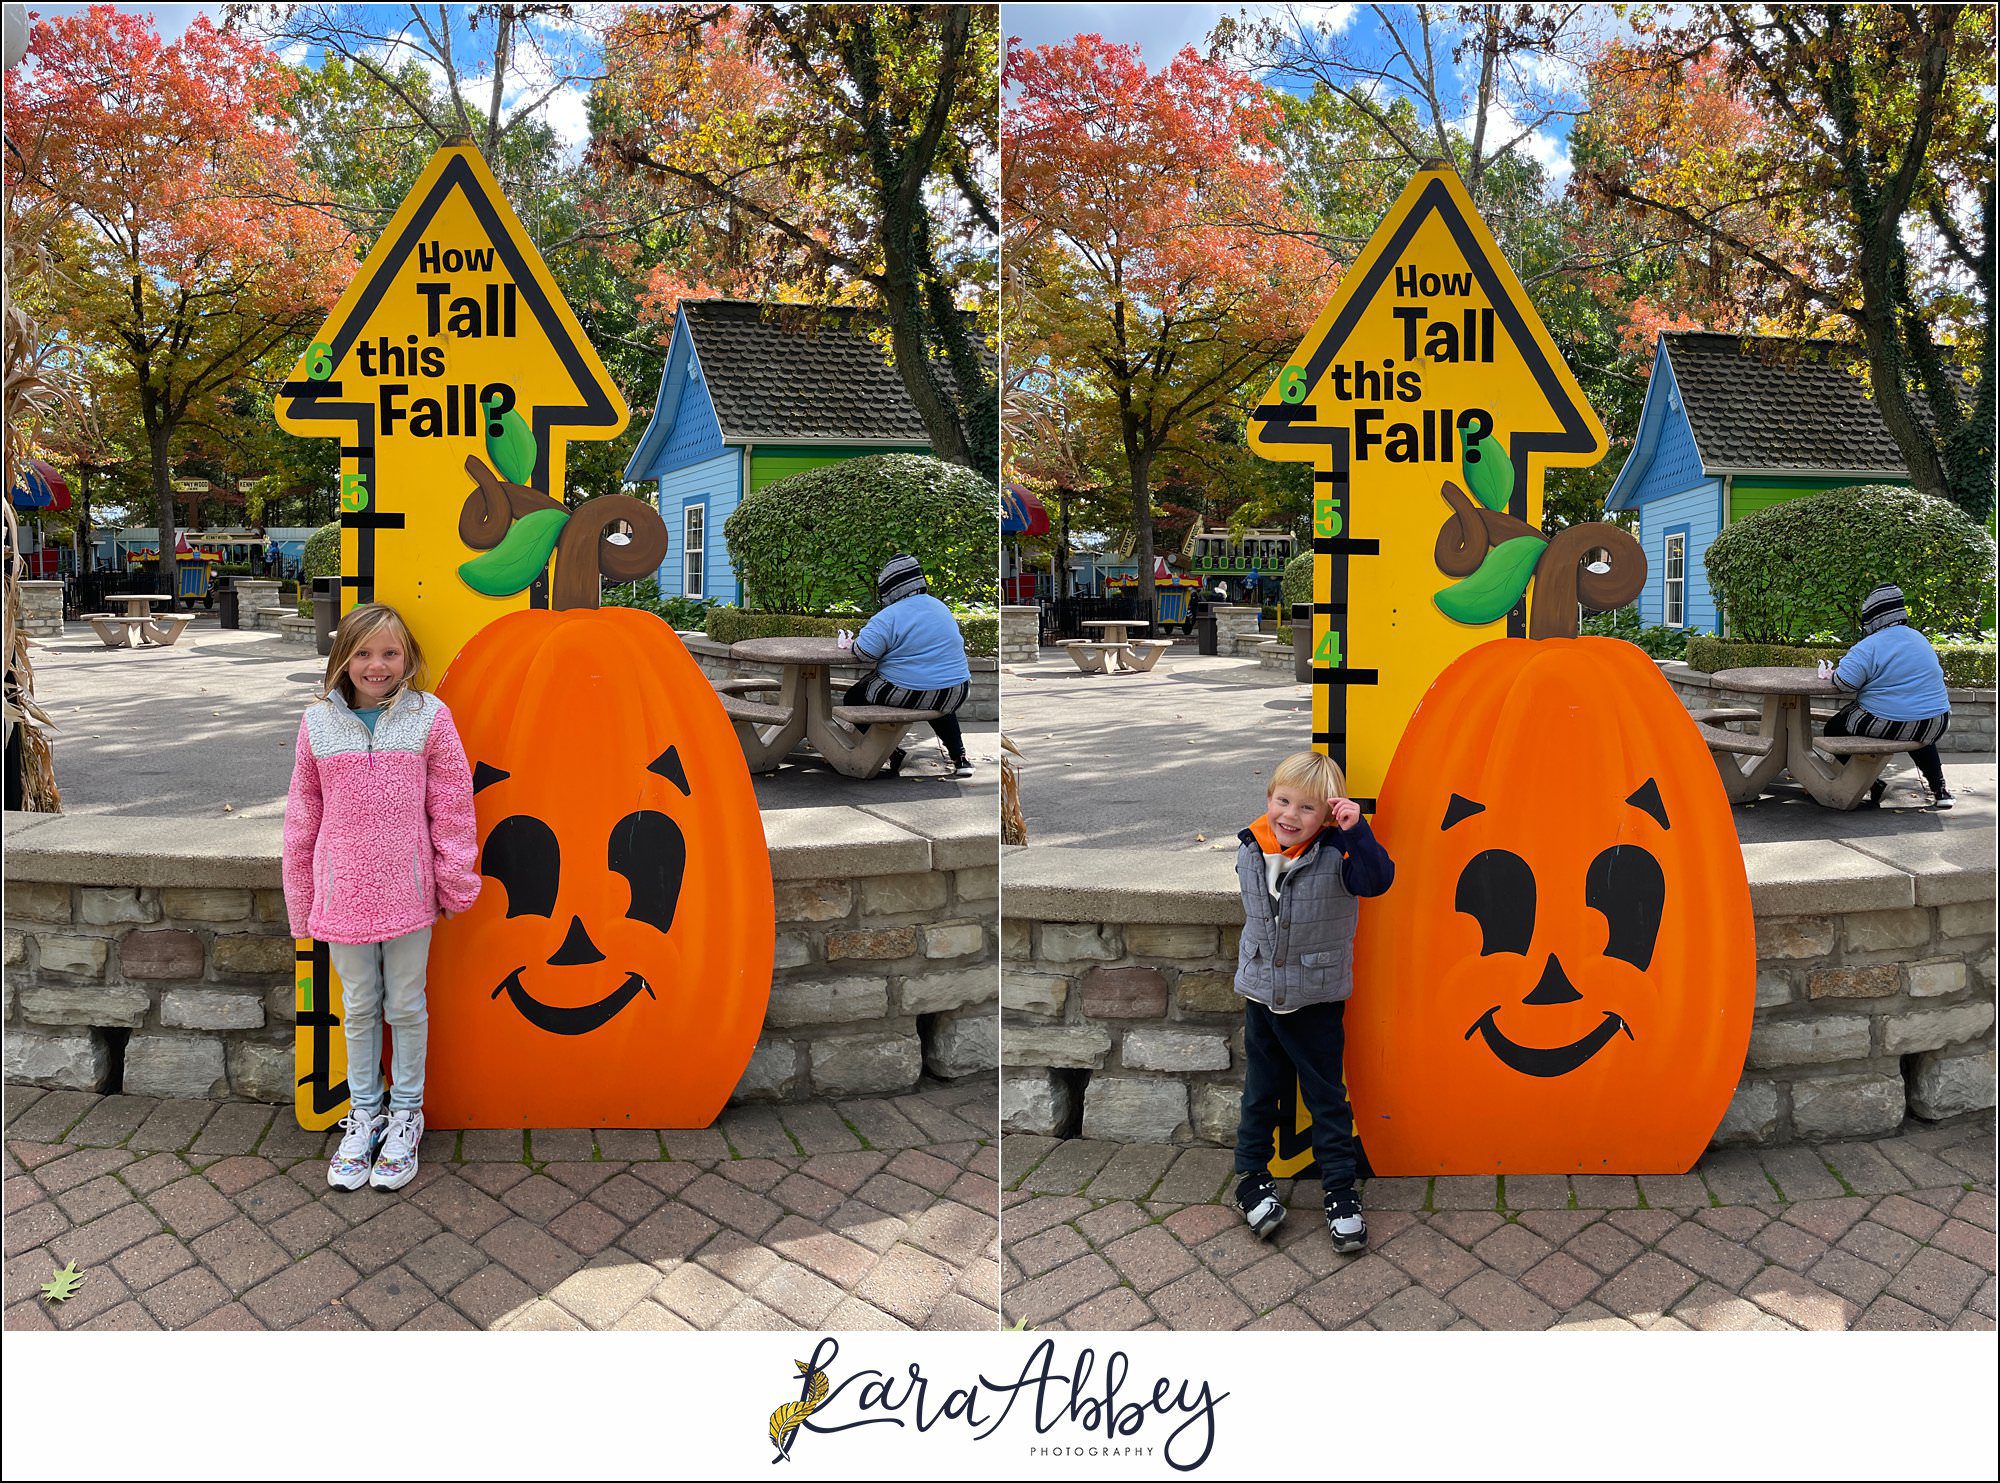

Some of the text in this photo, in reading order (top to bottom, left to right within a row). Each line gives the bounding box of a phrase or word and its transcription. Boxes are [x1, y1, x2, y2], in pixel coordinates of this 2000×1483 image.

[418, 241, 495, 273] How
[1395, 264, 1472, 298] How
[416, 283, 517, 338] Tall
[1392, 306, 1495, 363] Tall
[305, 342, 333, 381] 6
[356, 335, 445, 377] this
[1279, 365, 1307, 404] 6
[1331, 358, 1422, 403] this
[379, 382, 517, 438] Fall?
[1354, 408, 1494, 464] Fall?
[342, 474, 369, 511] 5
[1315, 499, 1342, 537] 5
[1314, 631, 1343, 668] 4
[298, 977, 312, 1011] 1
